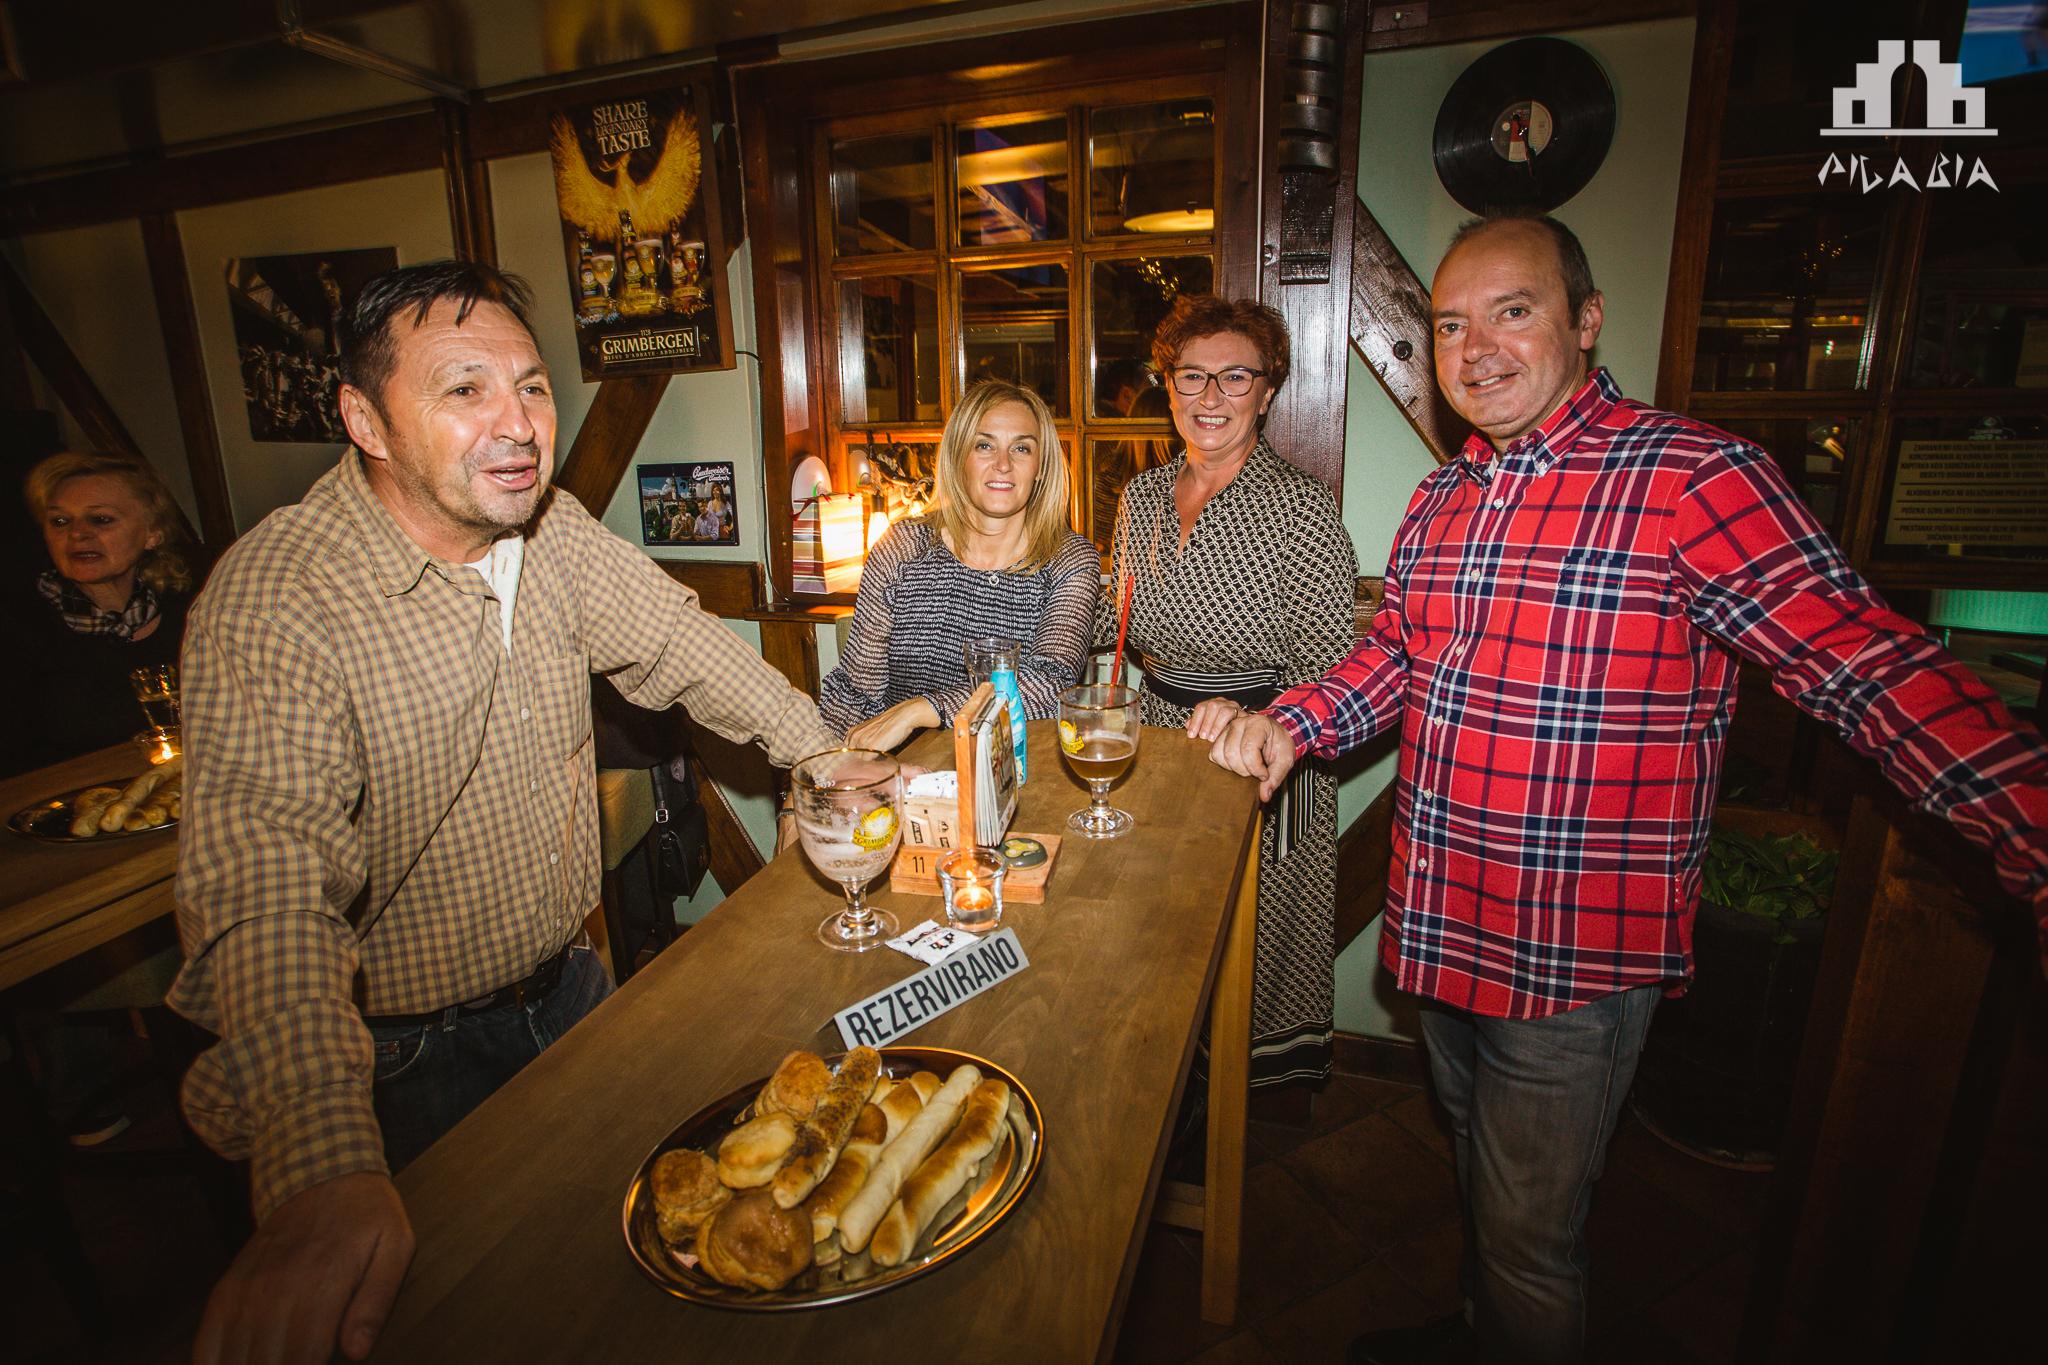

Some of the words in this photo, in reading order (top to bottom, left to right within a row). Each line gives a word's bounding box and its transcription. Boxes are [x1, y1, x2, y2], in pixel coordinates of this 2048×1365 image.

[593, 101, 648, 126] SHARE
[596, 118, 648, 137] LEGENDARY
[598, 130, 651, 155] TASTE
[602, 332, 694, 355] GRIMBERGEN
[913, 856, 925, 874] 11
[845, 937, 1020, 1046] REZERVIRANO
